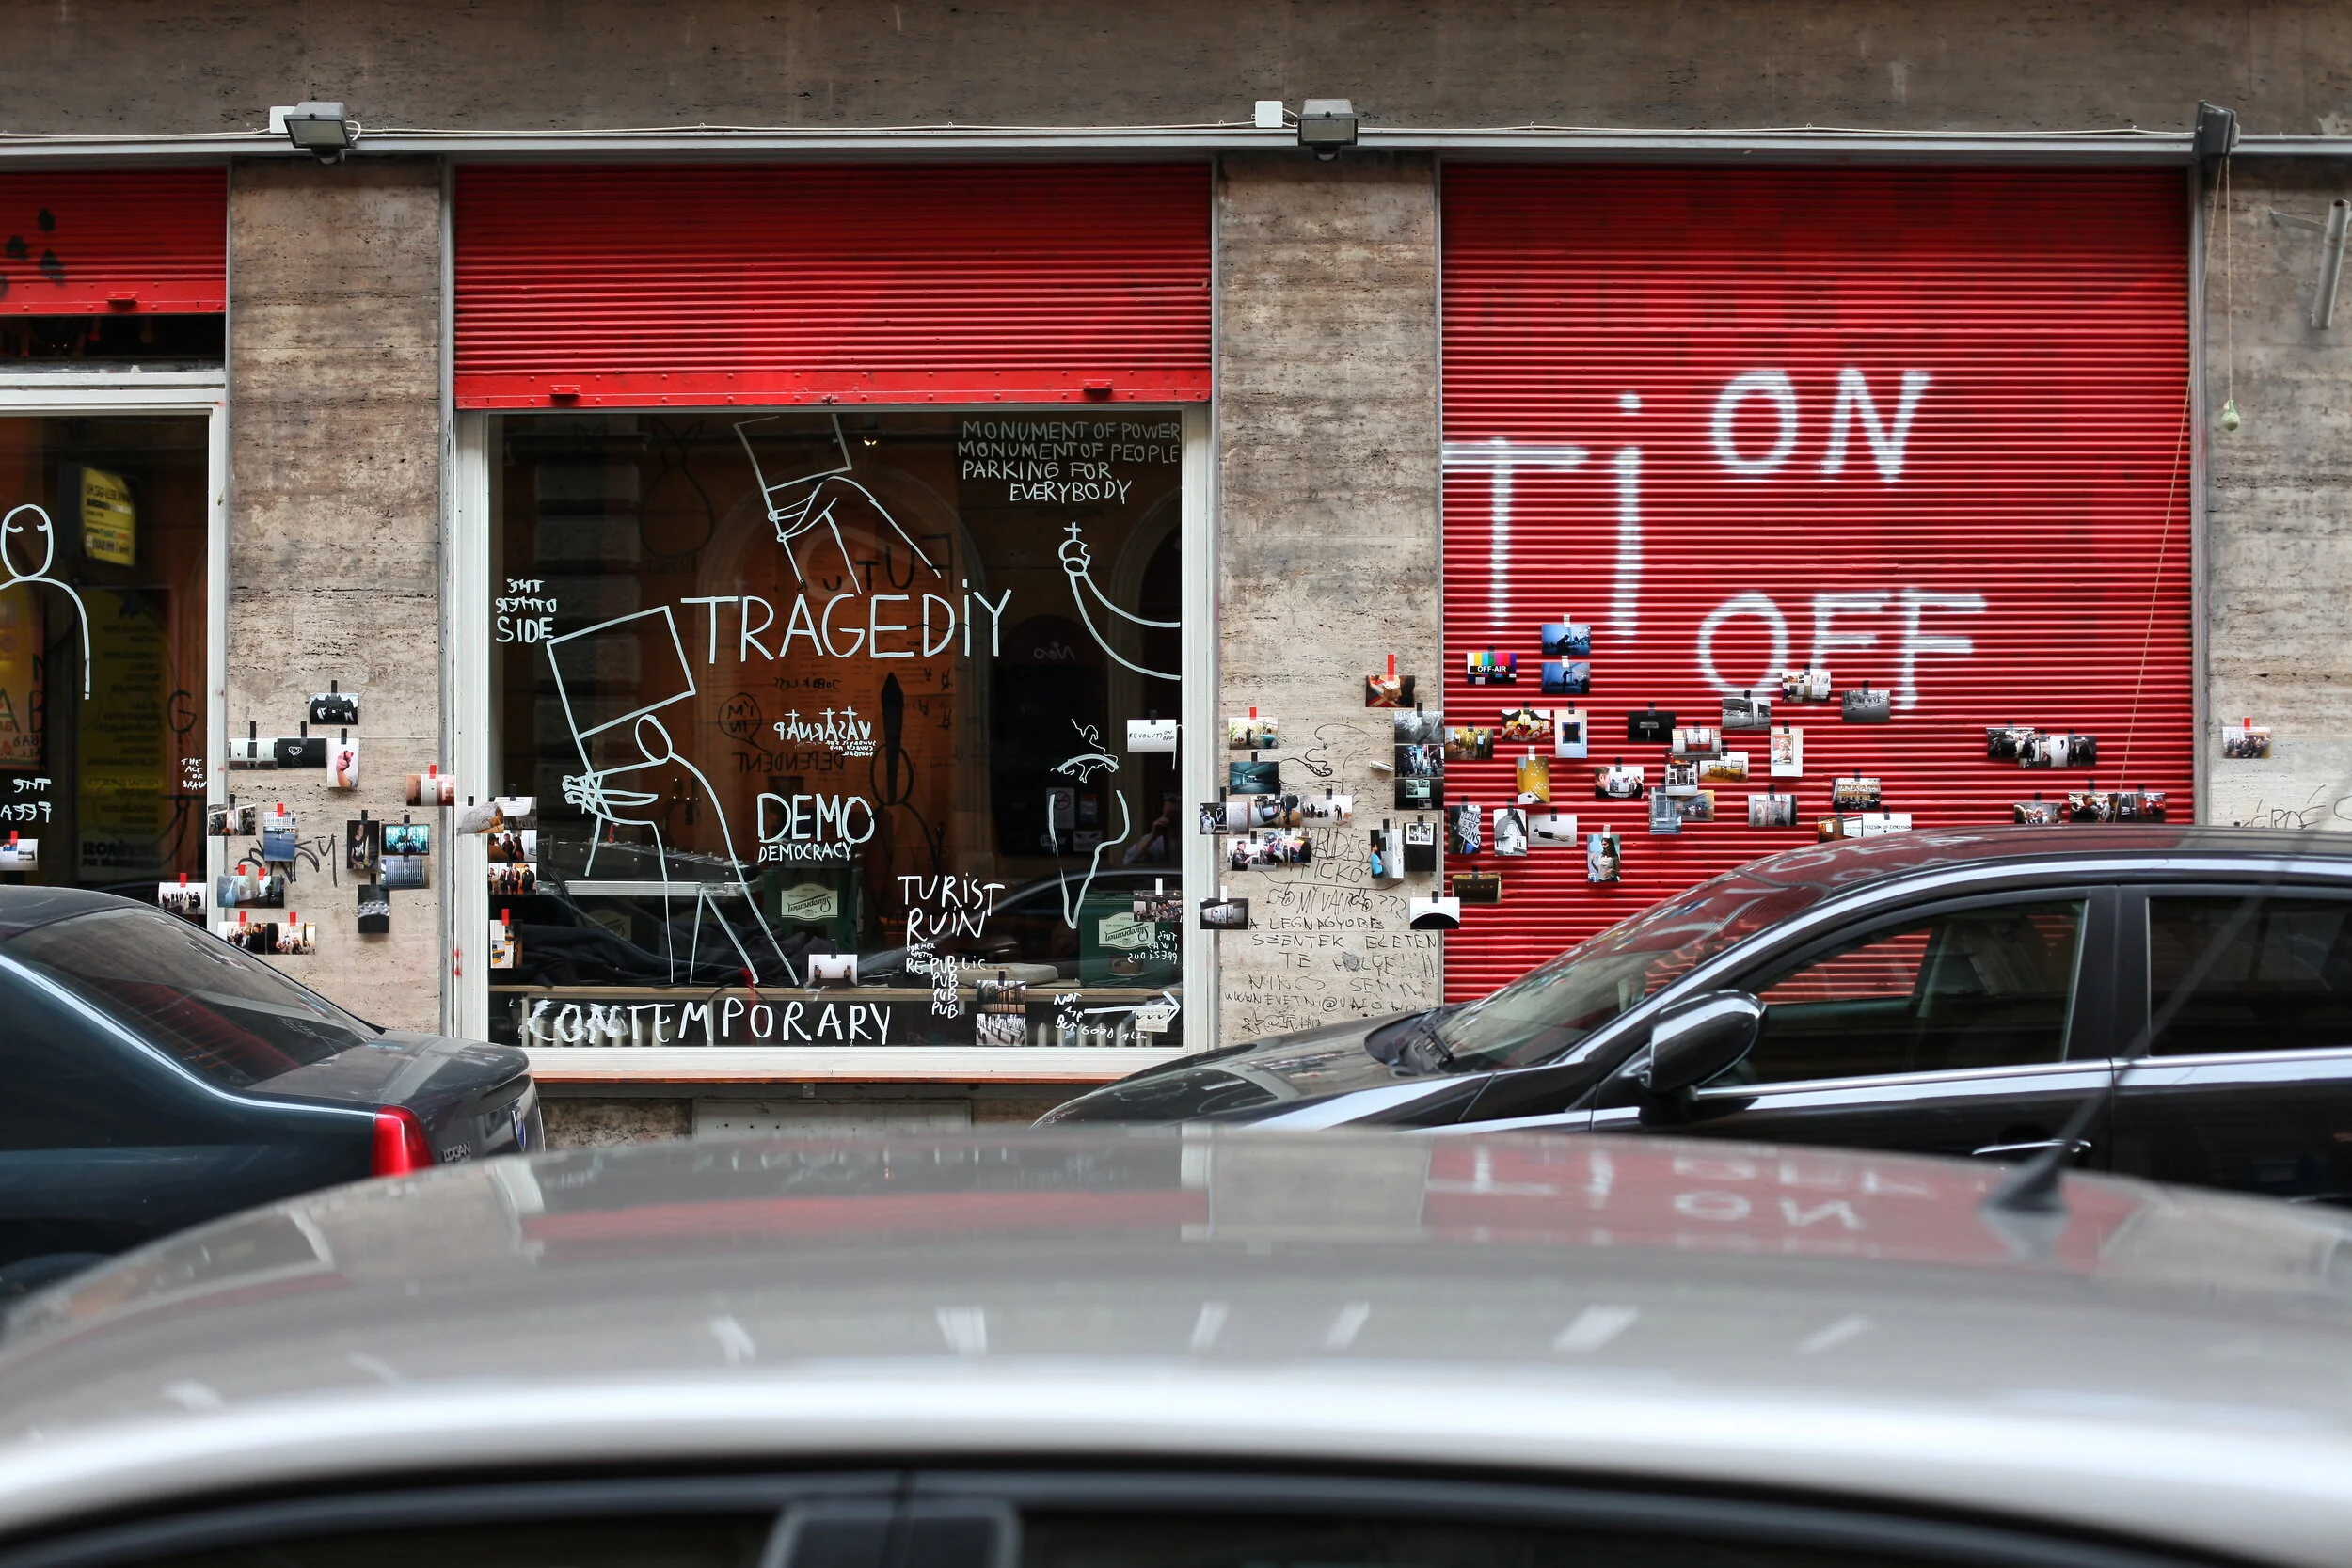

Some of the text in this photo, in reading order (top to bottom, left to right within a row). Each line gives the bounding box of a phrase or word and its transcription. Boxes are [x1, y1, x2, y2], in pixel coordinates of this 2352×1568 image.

[962, 420, 1180, 442] MONUMENT OF POWER
[1708, 368, 1932, 486] ON
[958, 441, 1180, 464] MONUMENT OF PEOPLE
[962, 460, 1112, 482] PARKING FOR
[1009, 479, 1133, 504] EVERYBODY
[495, 614, 555, 643] SIDE
[1696, 589, 1989, 710] OFF
[181, 757, 202, 767] THE
[756, 792, 876, 844] DEMO
[757, 841, 853, 863] DEMOCRACY
[931, 971, 959, 989] PUB
[932, 987, 959, 1002] PUB
[1054, 992, 1083, 1005] NOT
[931, 1001, 959, 1019] PUB
[1055, 1014, 1078, 1032] BUT
[441, 1141, 471, 1163] LOGAN
